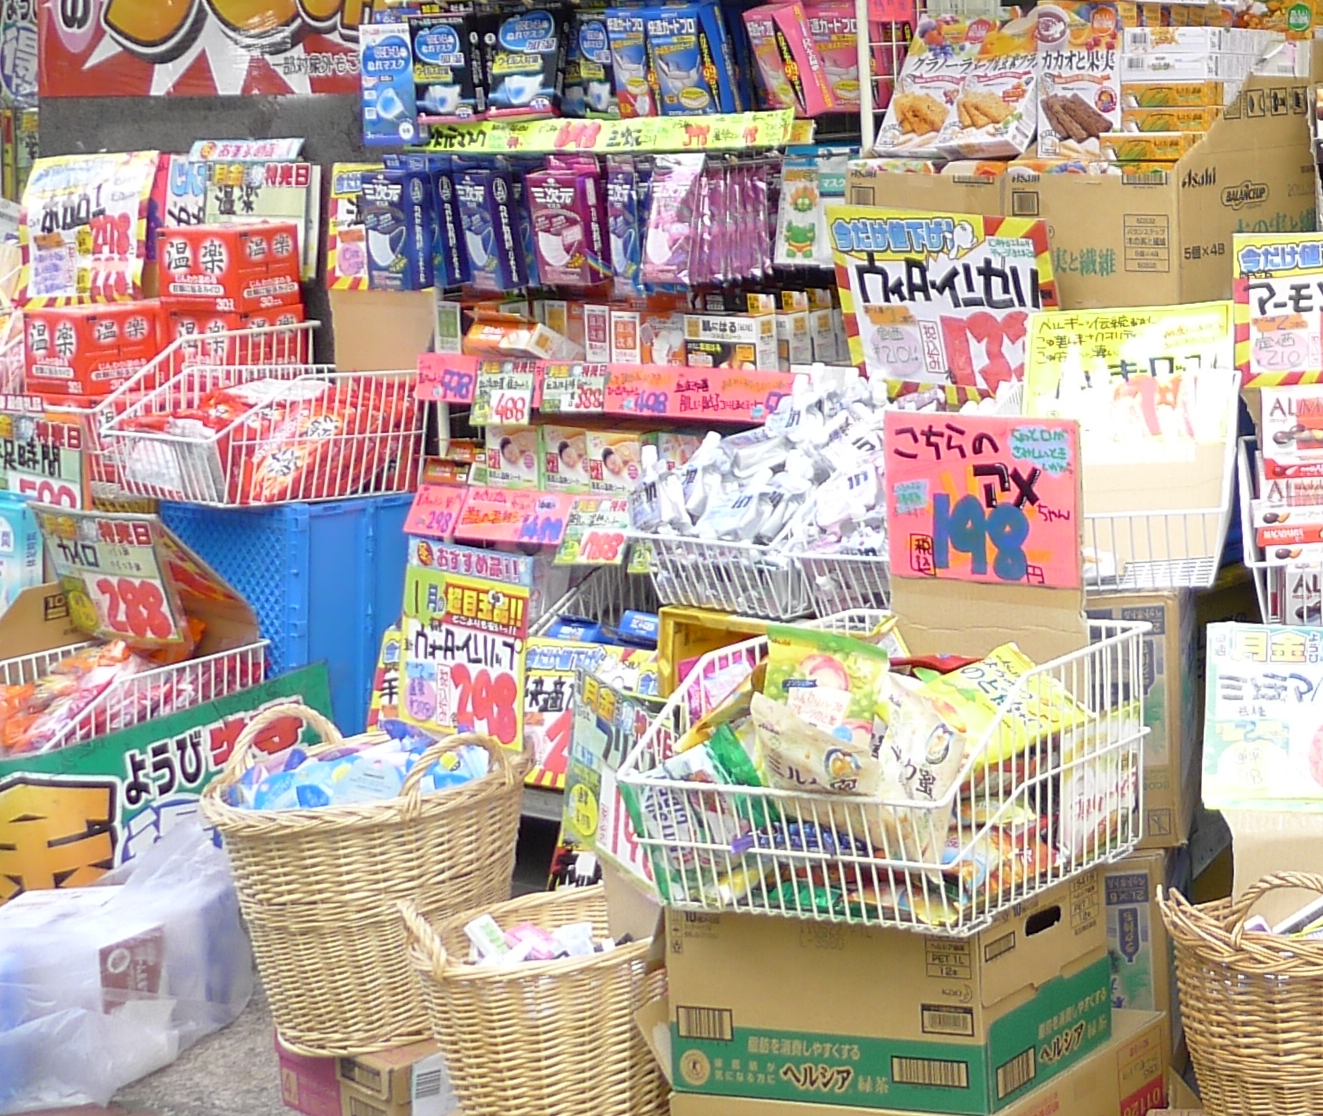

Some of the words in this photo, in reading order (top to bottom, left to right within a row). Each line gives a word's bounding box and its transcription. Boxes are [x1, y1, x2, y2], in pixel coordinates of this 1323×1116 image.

[56, 539, 99, 569] カイロ
[932, 493, 1029, 580] 198
[123, 729, 205, 805] ようび
[779, 1061, 853, 1094] ヘルシア
